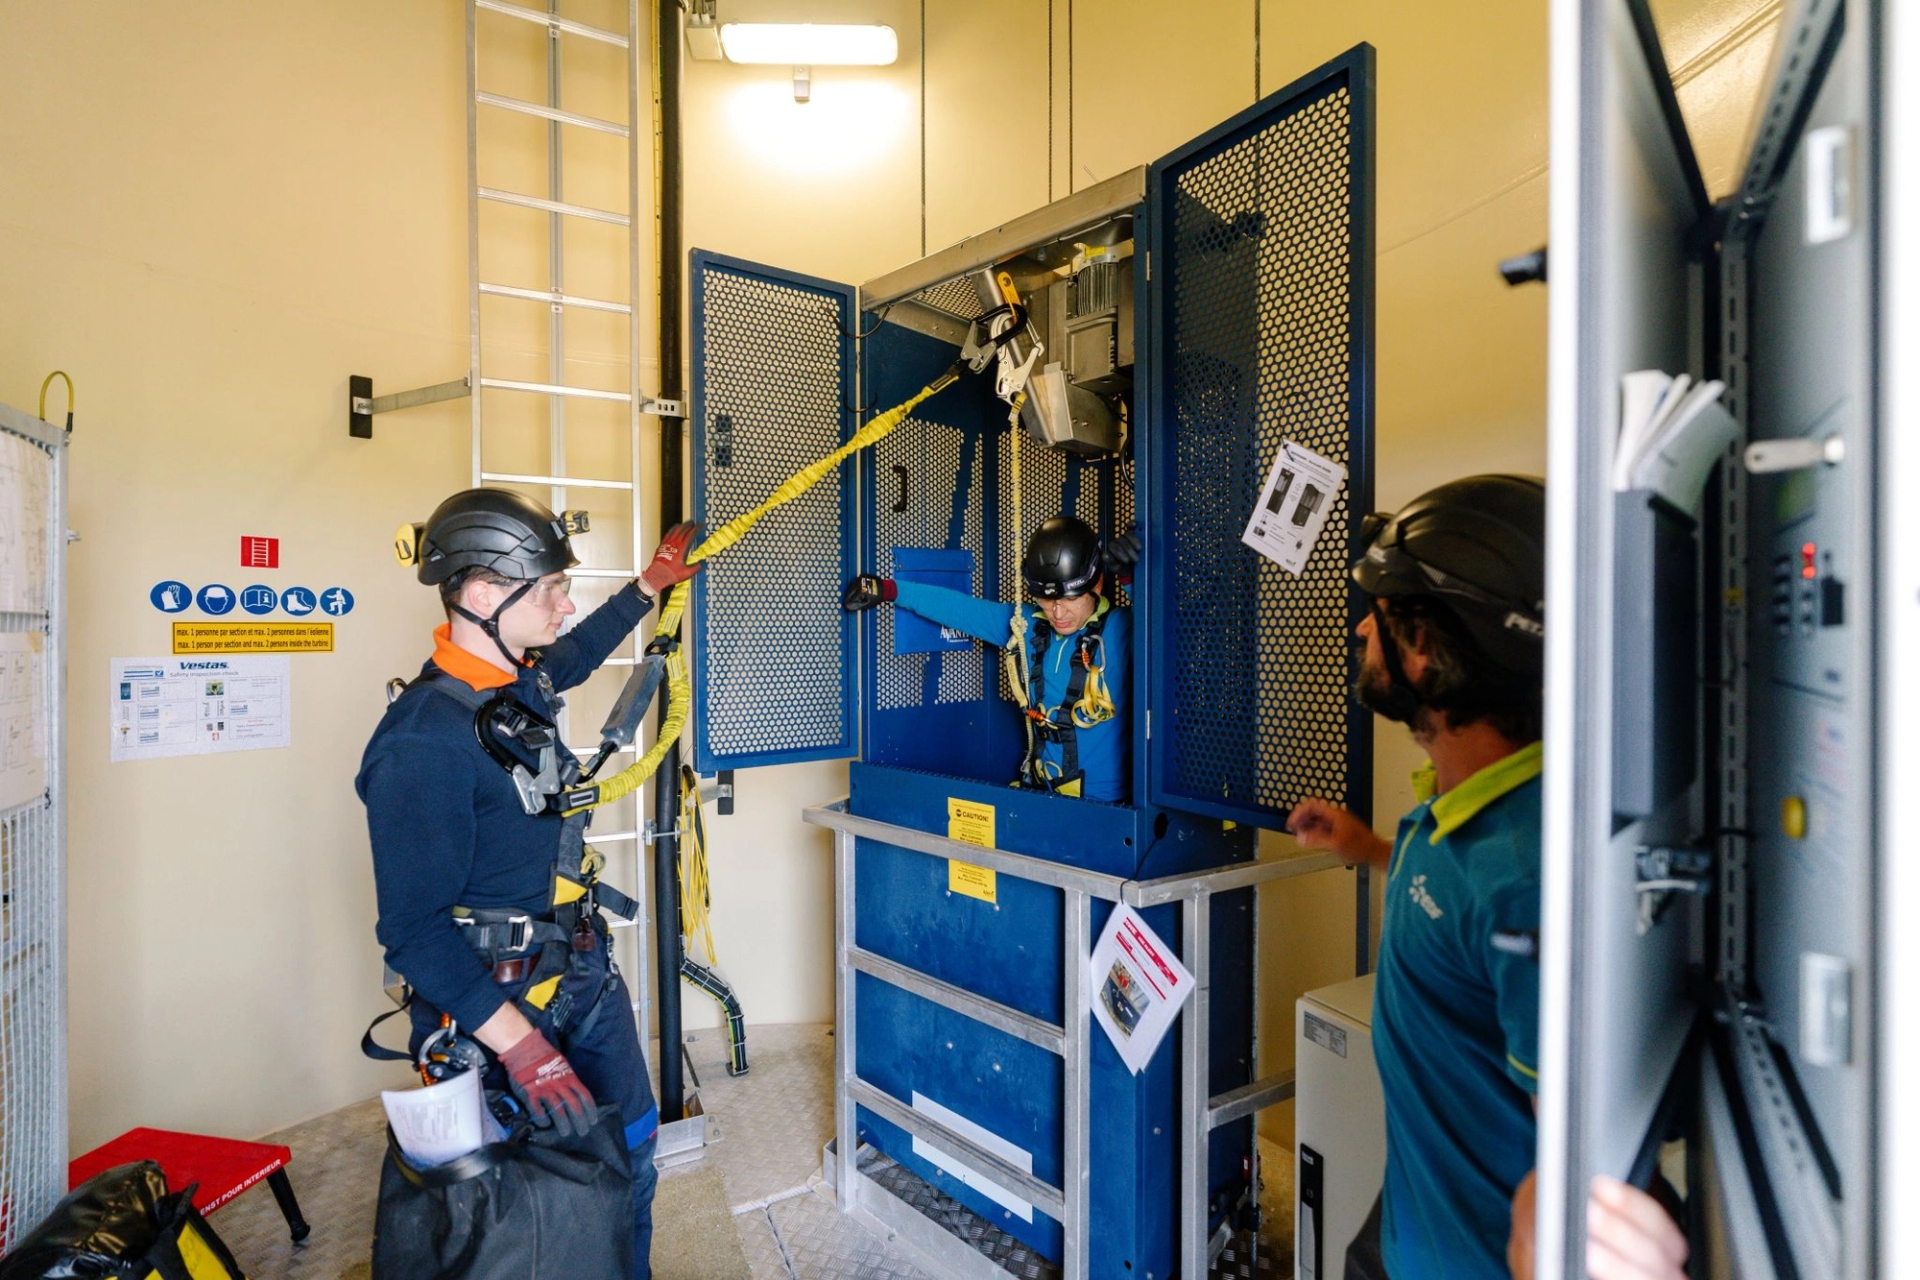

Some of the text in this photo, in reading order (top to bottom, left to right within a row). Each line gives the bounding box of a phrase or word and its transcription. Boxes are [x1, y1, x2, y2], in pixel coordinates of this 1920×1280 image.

[195, 629, 219, 638] personne
[219, 629, 228, 638] par
[229, 627, 247, 636] section
[247, 628, 253, 636] et
[271, 629, 295, 637] personnes
[295, 628, 306, 636] dans
[177, 641, 190, 649] max.
[196, 641, 214, 650] person
[214, 641, 223, 650] per
[224, 640, 242, 648] section
[242, 640, 252, 648] and
[252, 640, 265, 648] max.
[270, 640, 288, 649] persons
[289, 639, 303, 647] inside
[303, 639, 311, 647] the
[312, 639, 329, 647] turbine
[180, 661, 228, 670] Vestas
[200, 1158, 281, 1216] ENST POUR INTERIEUR
